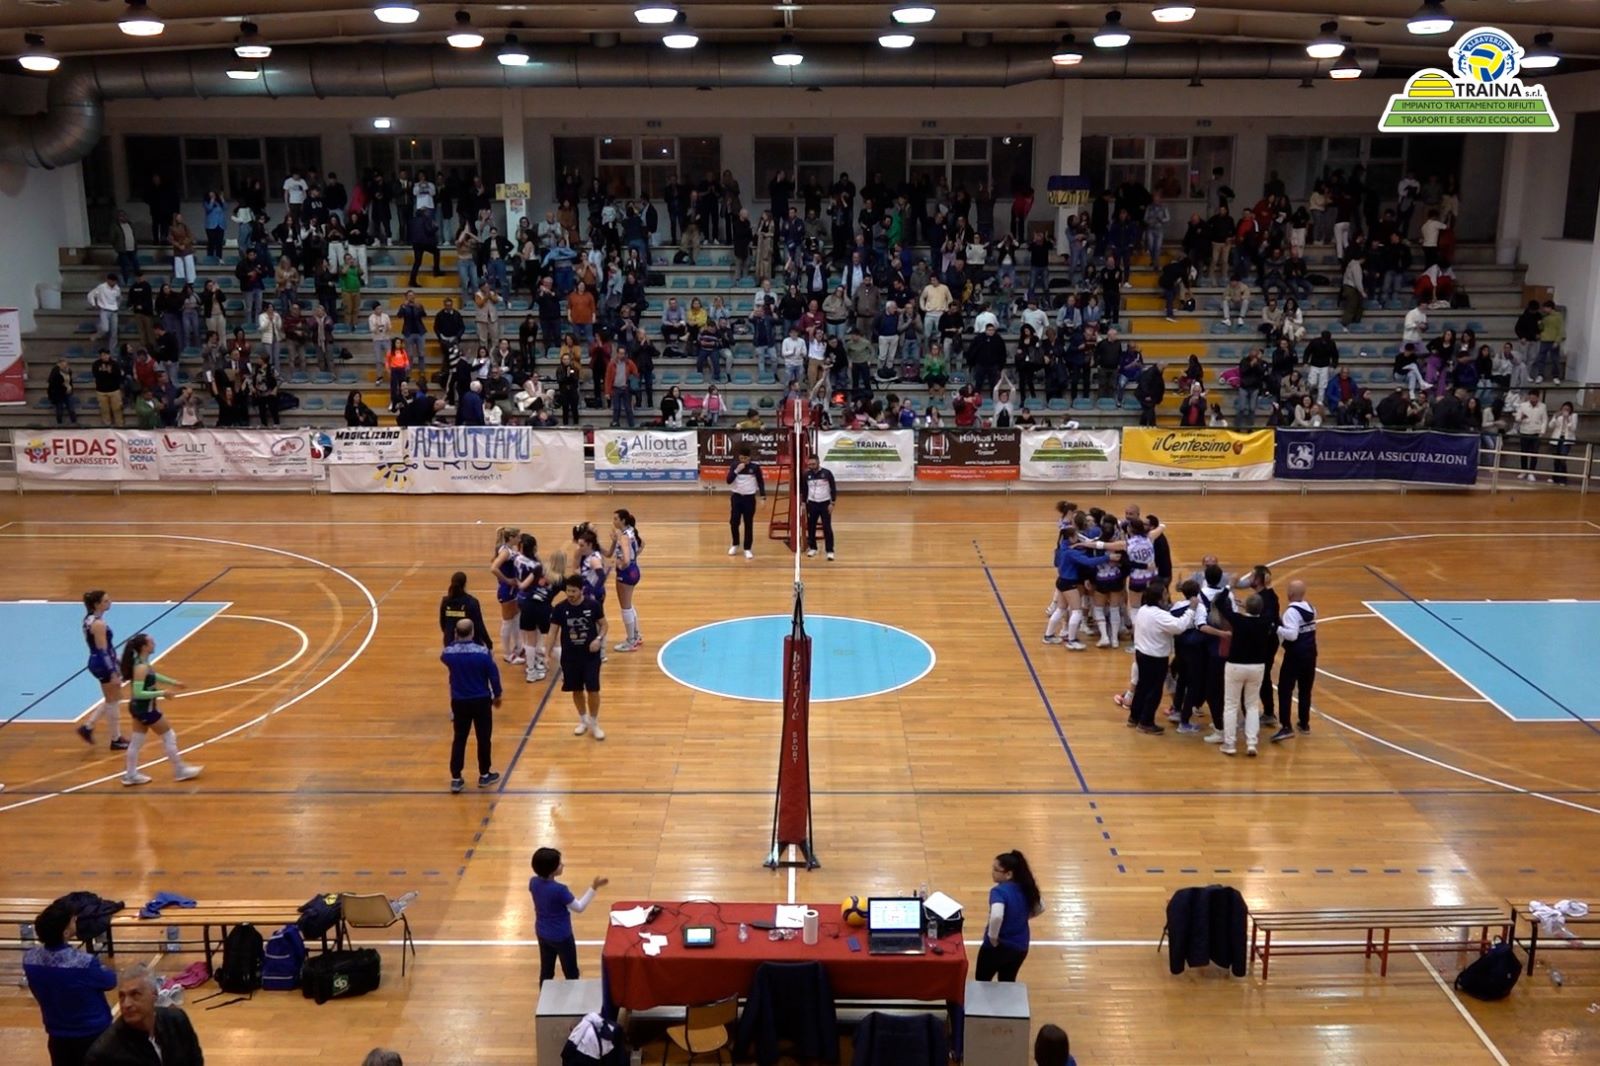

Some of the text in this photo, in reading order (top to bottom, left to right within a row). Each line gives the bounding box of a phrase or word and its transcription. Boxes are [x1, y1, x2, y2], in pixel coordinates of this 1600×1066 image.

[413, 428, 530, 460] AMMUTTAMU
[631, 434, 687, 451] Aliotta
[742, 433, 774, 444] Halykos
[959, 433, 1015, 444] Halykos Hotel
[1063, 440, 1094, 448] TRAINA
[1152, 433, 1232, 453] il Centesimo
[52, 439, 117, 456] FIDAS
[185, 443, 207, 453] LILT
[53, 457, 119, 465] CALTANISSETTA
[129, 455, 155, 463] DONA
[1316, 451, 1468, 466] ALLEANZA ASSICURAZIONI
[129, 463, 149, 471] VITA
[791, 731, 799, 764] SPORT
